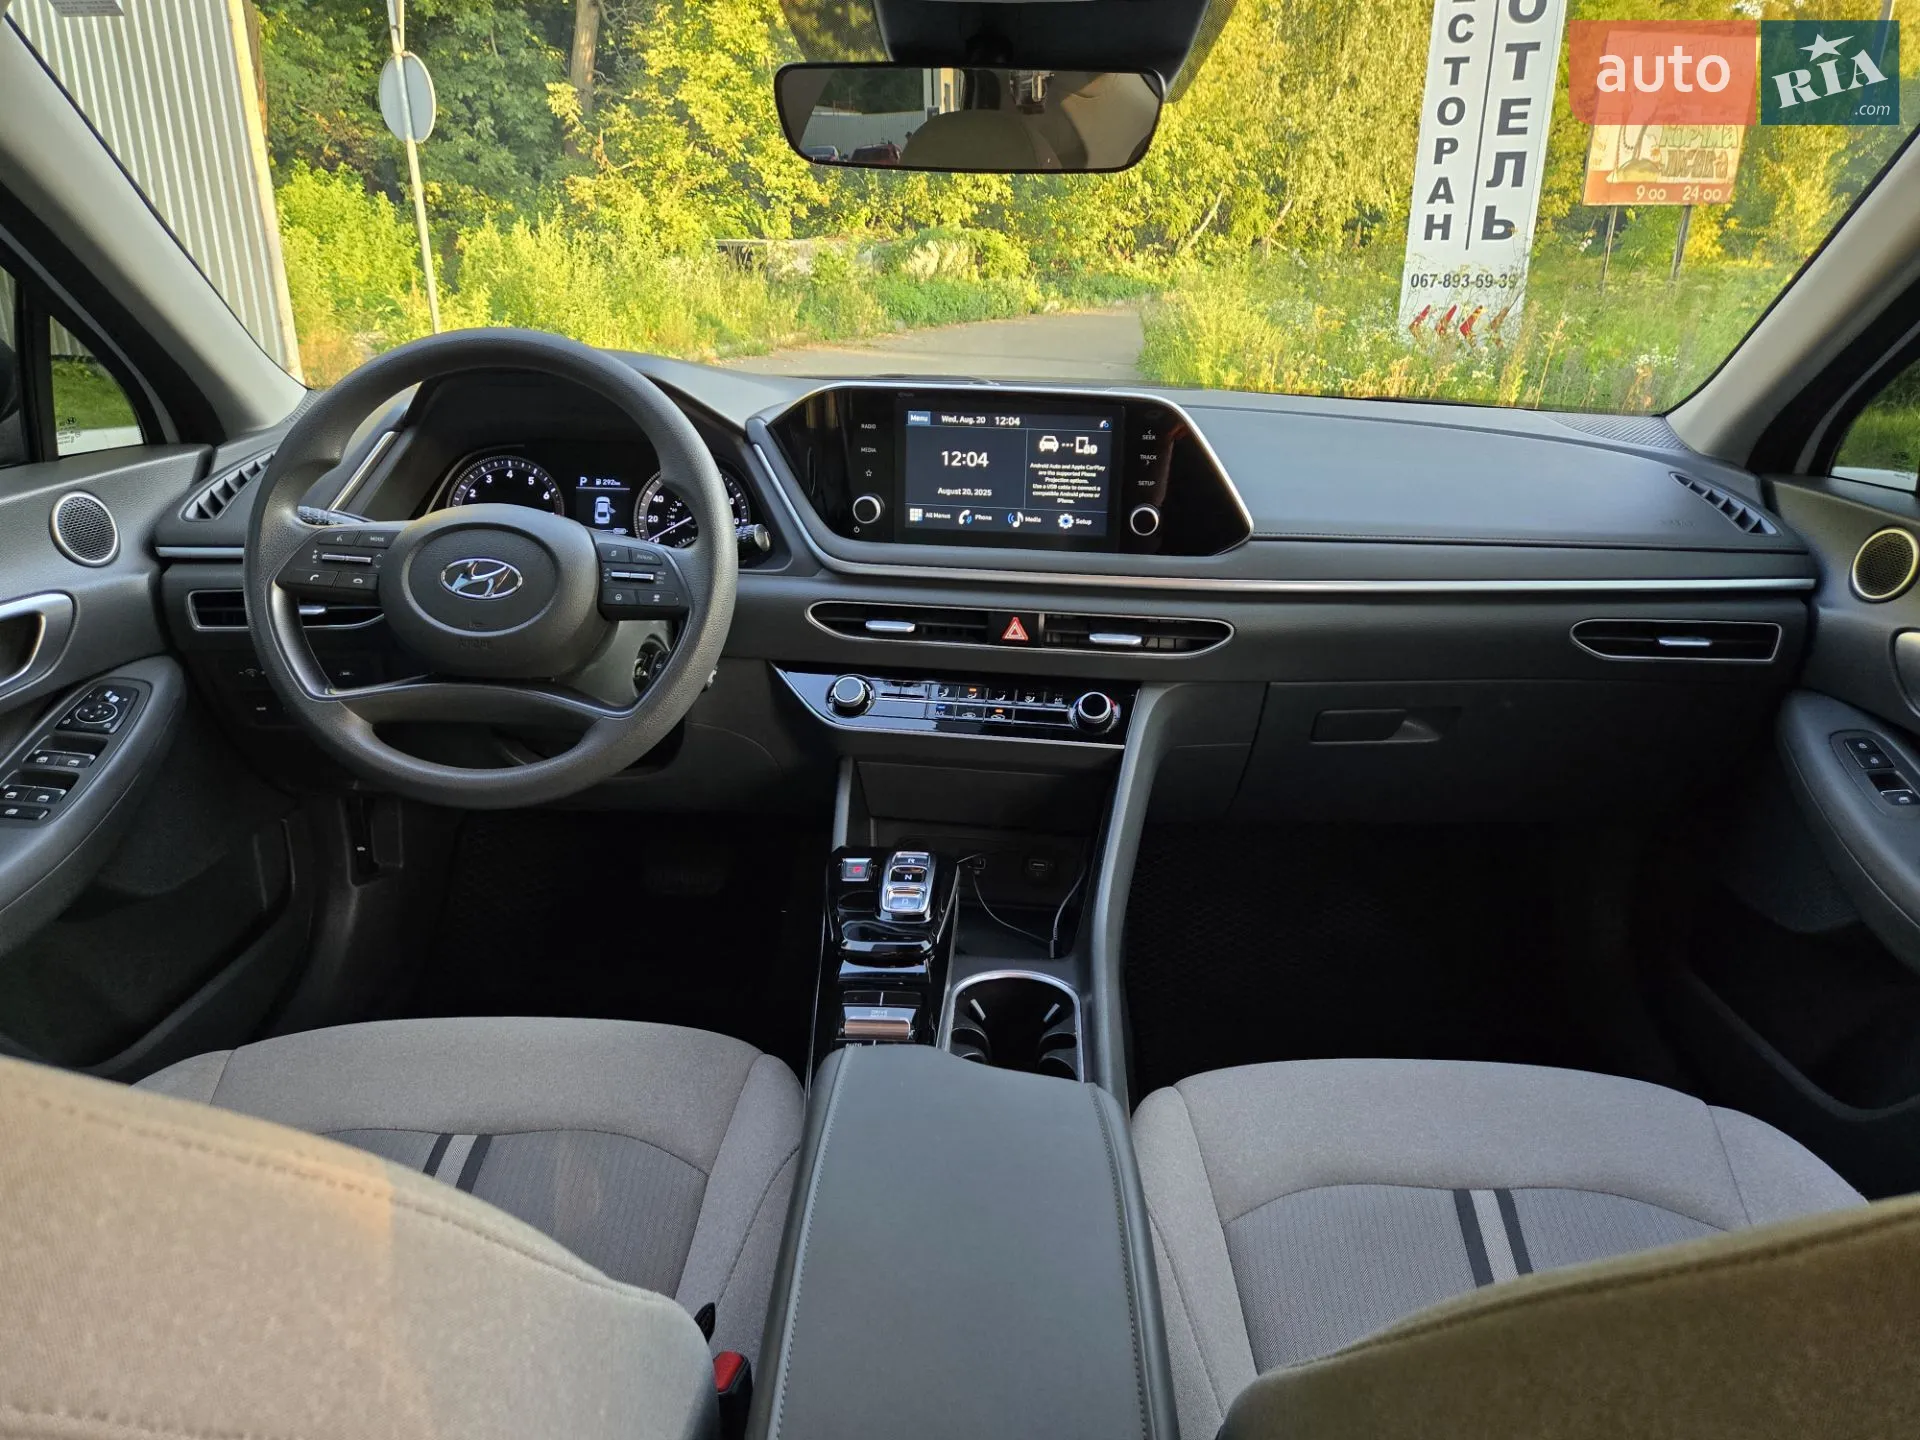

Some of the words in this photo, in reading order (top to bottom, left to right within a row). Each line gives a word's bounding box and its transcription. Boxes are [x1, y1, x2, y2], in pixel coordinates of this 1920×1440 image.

[1423, 0, 1475, 241] СТОРАН
[910, 414, 928, 422] Menu
[942, 415, 958, 424] Wed,
[960, 416, 975, 425] Aug.
[976, 416, 987, 424] 20
[994, 416, 1021, 426] 12:04
[941, 450, 989, 467] 12:04
[506, 470, 514, 479] 4
[485, 475, 493, 484] 3
[528, 476, 535, 486] 5
[580, 476, 588, 486] P
[469, 489, 477, 498] 2
[543, 491, 550, 500] 6
[937, 487, 961, 496] August
[962, 488, 973, 496] 20,
[974, 488, 992, 496] 2025
